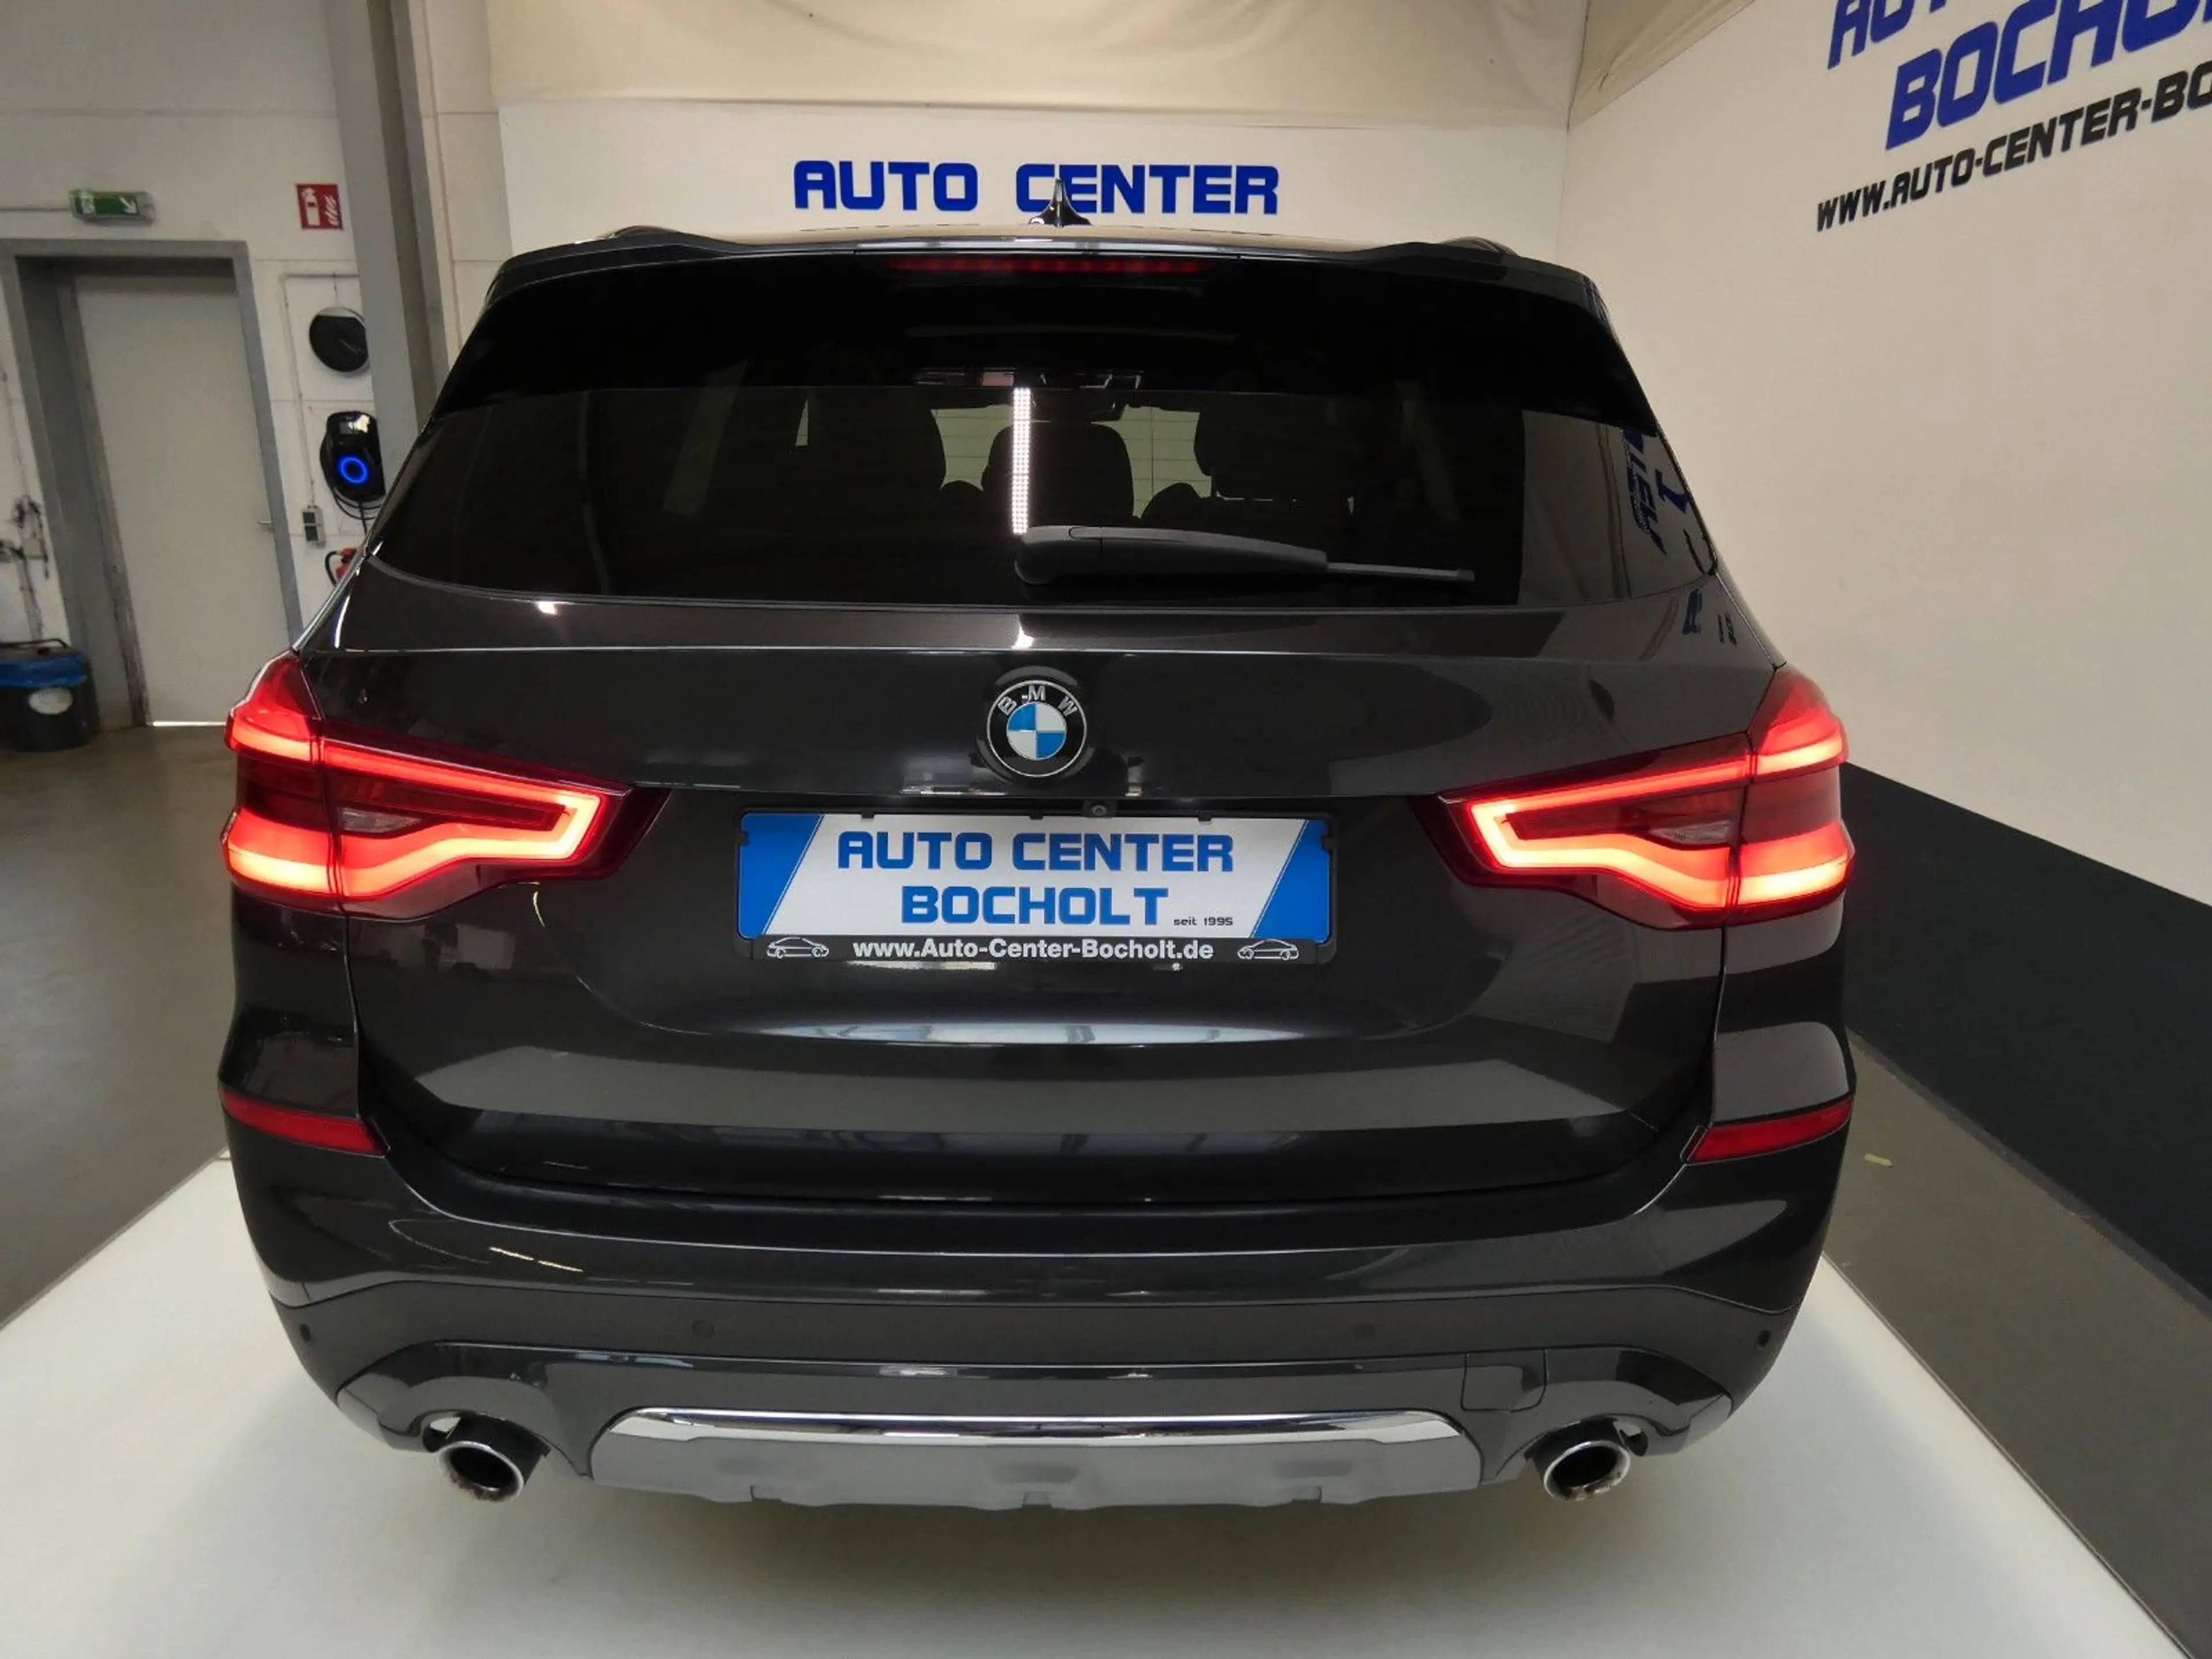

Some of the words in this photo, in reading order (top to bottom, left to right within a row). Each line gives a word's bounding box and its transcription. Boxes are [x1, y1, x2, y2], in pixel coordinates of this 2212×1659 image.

[793, 160, 978, 211] AUTO
[1016, 164, 1280, 215] CENTER
[998, 685, 1078, 717] BMW
[838, 831, 993, 870] AUTO
[1012, 833, 1233, 872] CENTER
[902, 885, 1168, 926] BOCHOLT
[1173, 916, 1198, 926] seit
[1204, 916, 1233, 926] 1995
[853, 938, 1214, 960] www.Auto-Center-Bocholt.de
